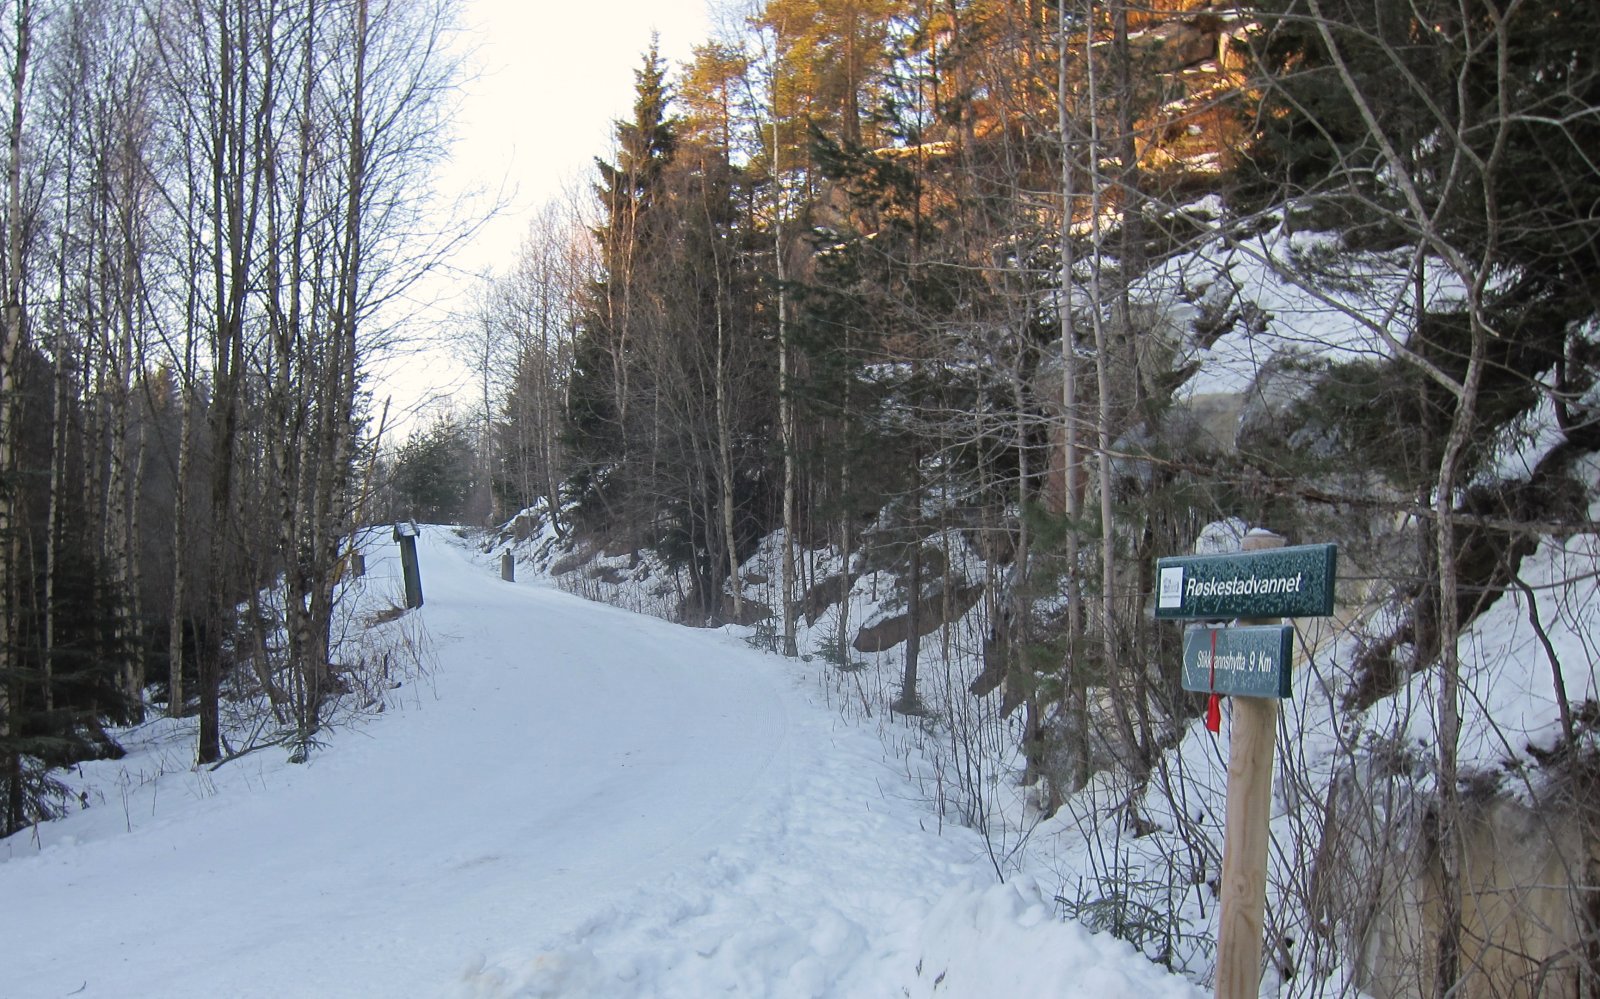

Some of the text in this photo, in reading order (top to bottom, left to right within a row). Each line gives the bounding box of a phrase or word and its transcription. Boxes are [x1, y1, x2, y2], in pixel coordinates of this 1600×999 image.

[1185, 572, 1302, 597] Røskestadvannet
[1196, 649, 1272, 674] Stikkannshytta 9 Km
